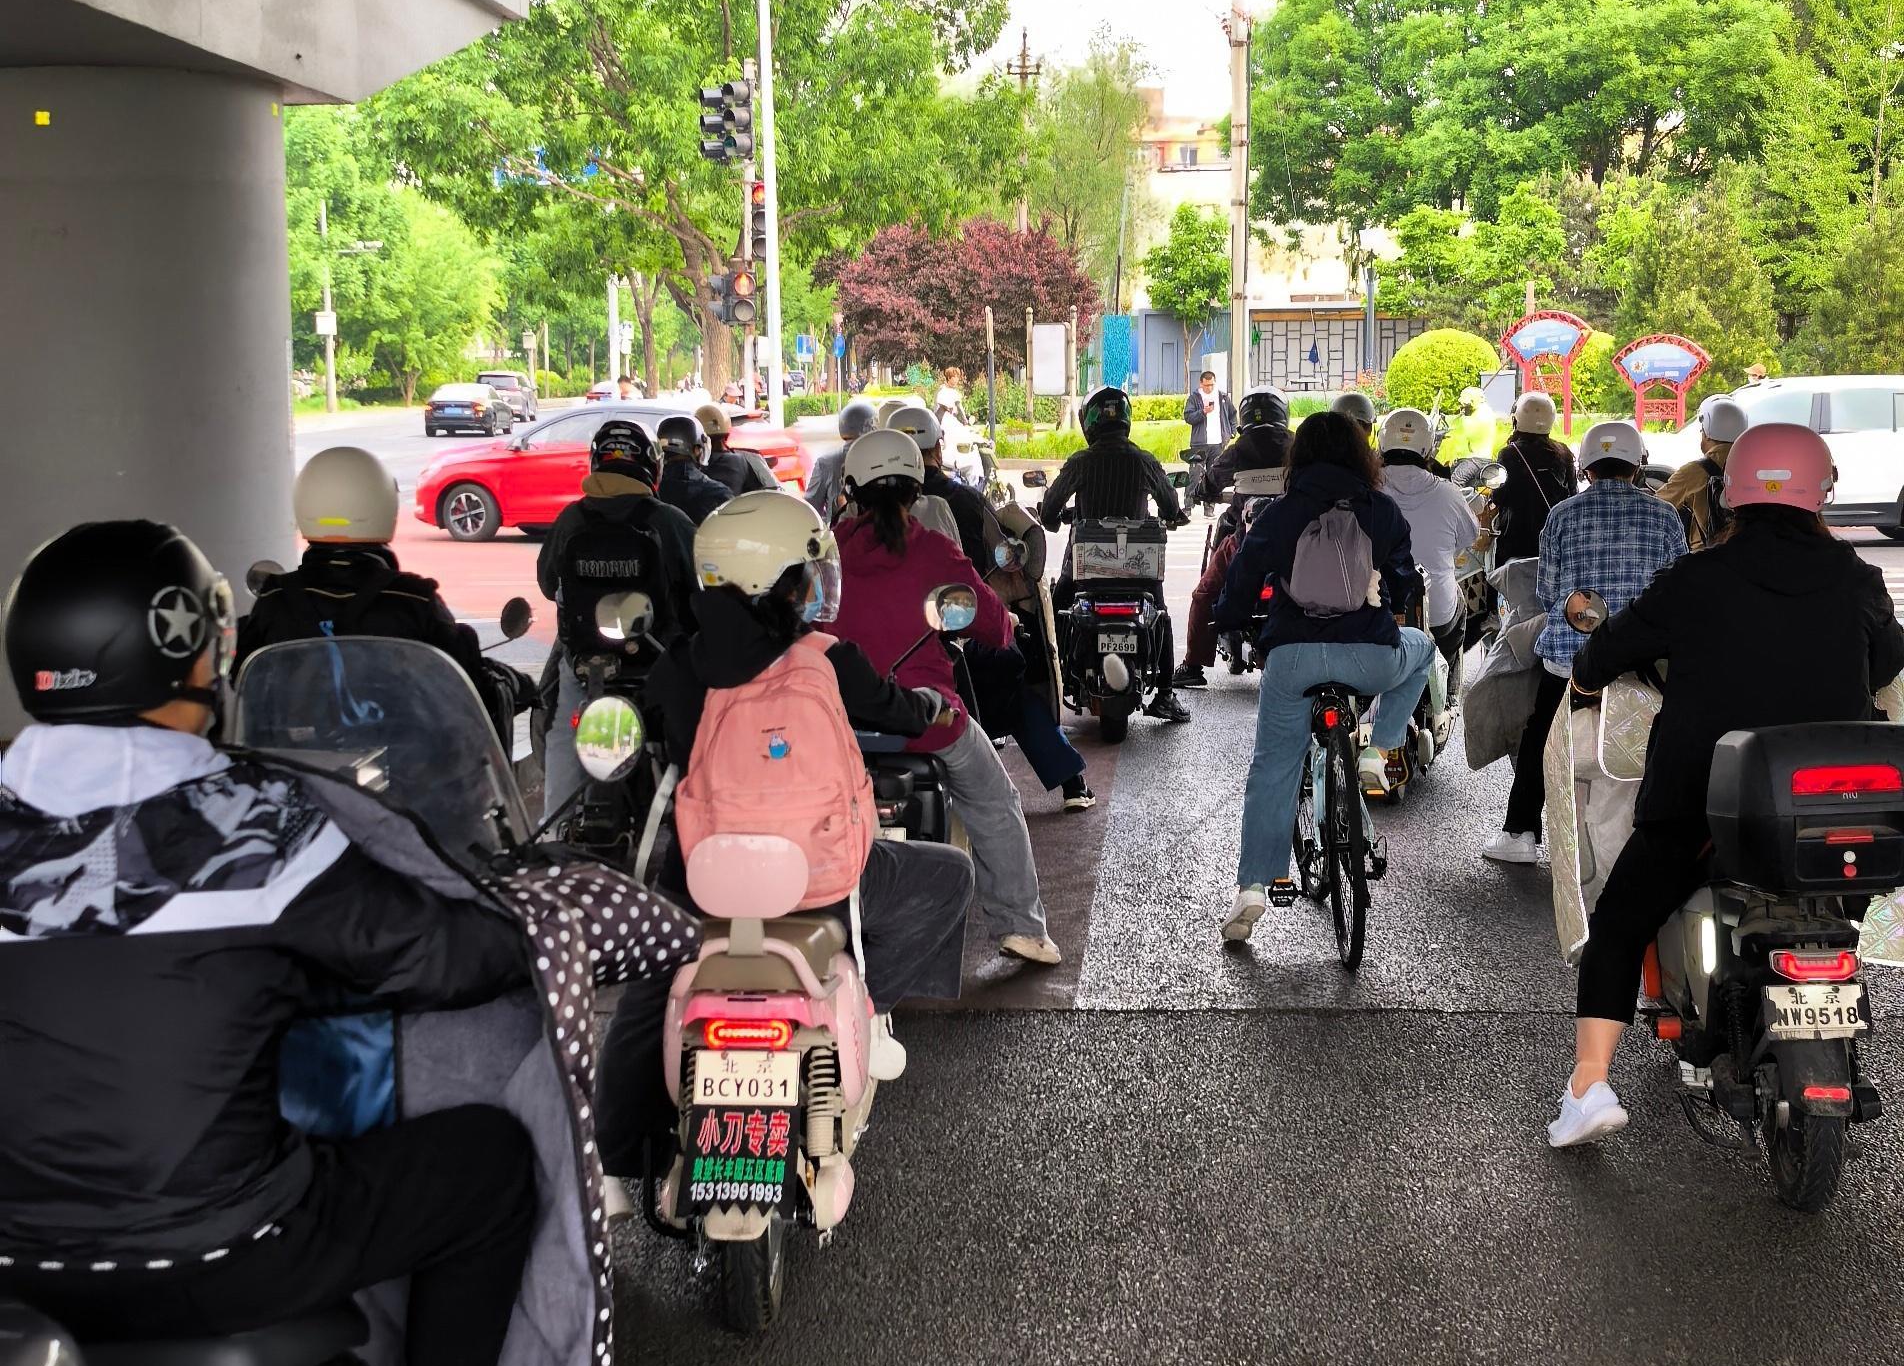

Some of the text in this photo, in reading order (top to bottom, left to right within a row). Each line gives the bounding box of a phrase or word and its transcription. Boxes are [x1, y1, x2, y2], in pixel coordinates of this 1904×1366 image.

[1101, 642, 1136, 652] PF2699
[1791, 990, 1840, 1005] 北京
[1776, 1007, 1859, 1026] NW9518
[722, 1056, 773, 1074] 北京
[703, 1078, 788, 1097] BCY031
[697, 1108, 790, 1157] 小刀专卖
